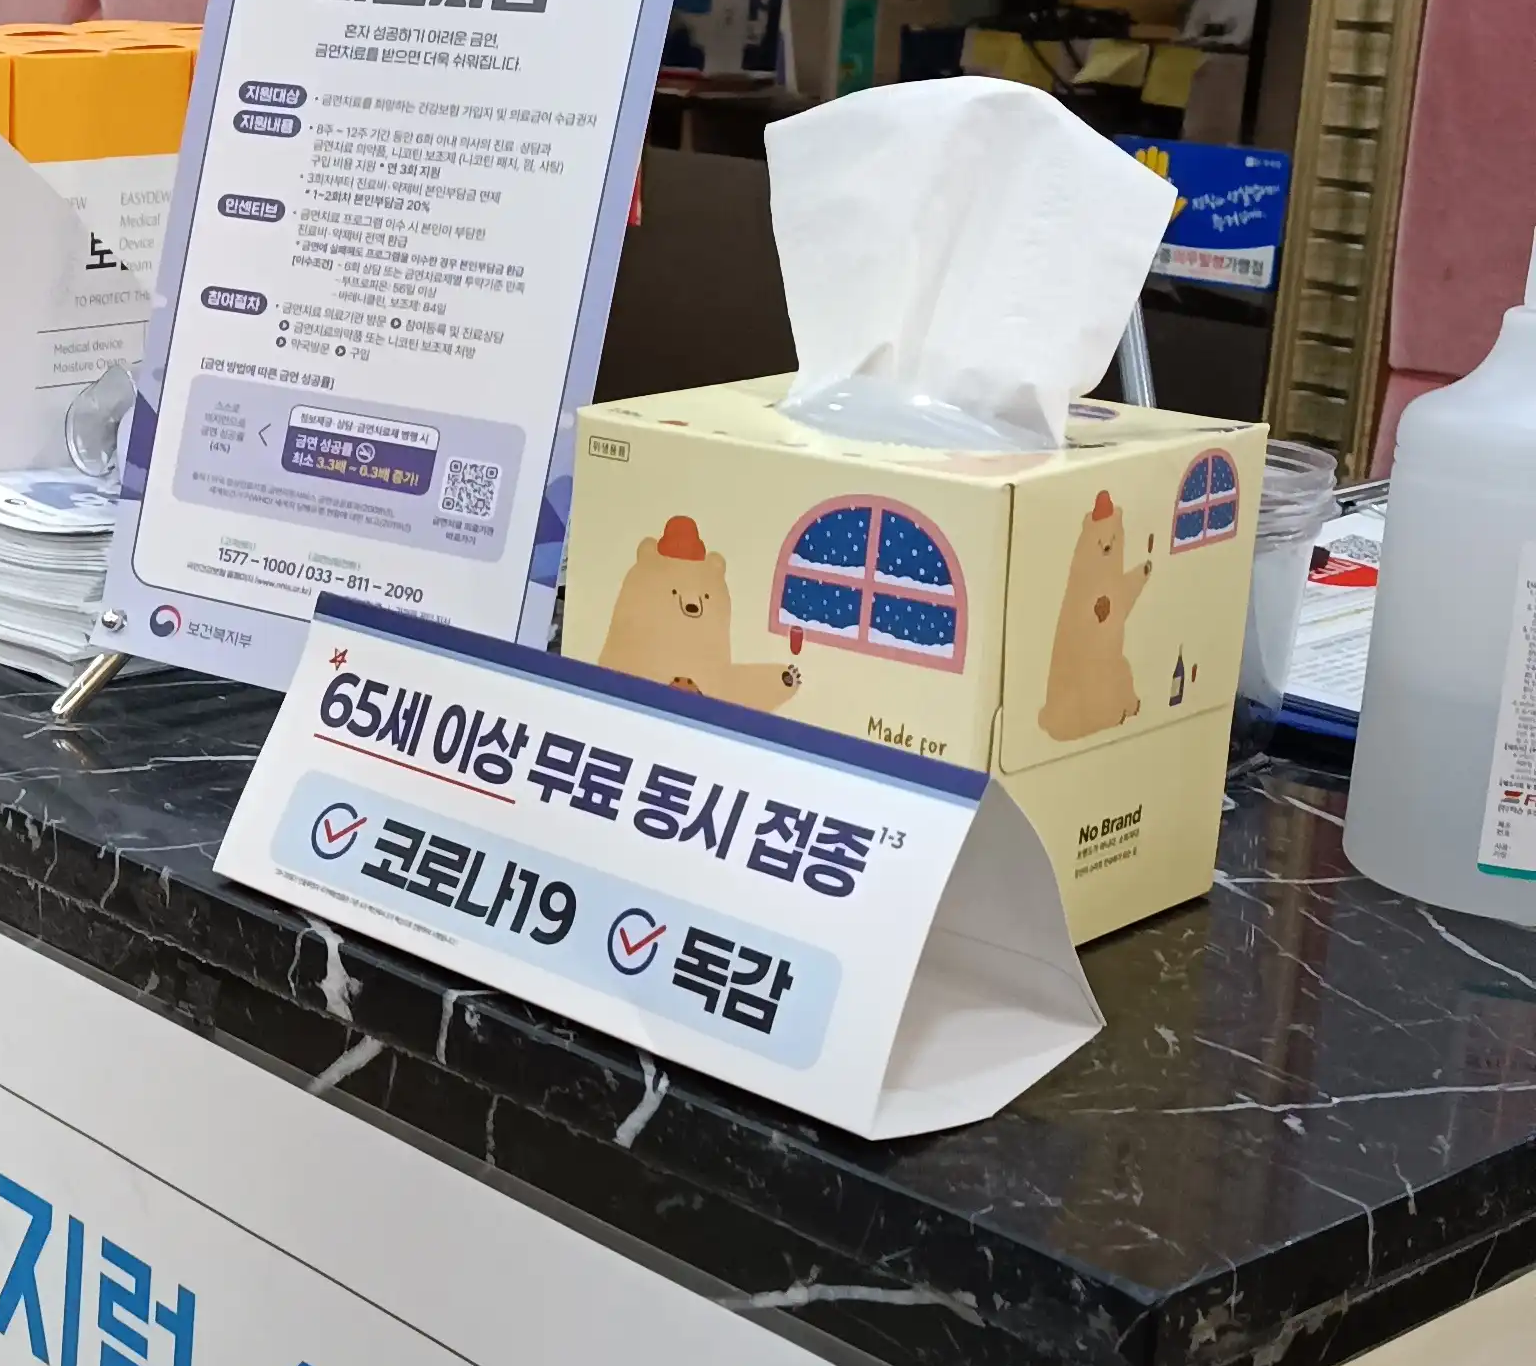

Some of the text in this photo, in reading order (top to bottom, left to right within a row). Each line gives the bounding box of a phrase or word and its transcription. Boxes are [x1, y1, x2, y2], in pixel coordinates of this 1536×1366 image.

[344, 23, 369, 40] 혼자
[373, 25, 425, 42] 성공하기
[427, 28, 468, 46] 어려운
[314, 43, 379, 62] 금연치료를
[381, 47, 421, 66] 받으면
[423, 50, 449, 68] 더욱
[244, 85, 301, 105] 지원대상
[238, 113, 294, 134] 지원내용
[419, 164, 441, 180] 지원
[120, 190, 172, 207] EASYDEW
[225, 196, 279, 219] 인센티브
[407, 198, 431, 214] 20%
[119, 213, 161, 229] Medical
[118, 236, 155, 252] Device
[74, 295, 88, 308] TO
[89, 290, 131, 306] PROTECT
[207, 289, 261, 312] 참여절차
[53, 339, 124, 356] Medical device
[52, 359, 95, 374] Moisture
[217, 546, 249, 567] 1577
[262, 555, 297, 577] 1000
[304, 564, 333, 585] 033
[383, 582, 424, 604] 2090
[187, 620, 253, 649] 보건복지부
[865, 713, 949, 759] Made for
[318, 669, 907, 899] 65세 이상 무료 동시 접종 1-3
[1078, 802, 1143, 845] No Brand
[359, 815, 579, 948] 코로나19
[670, 923, 796, 1036] 독감
